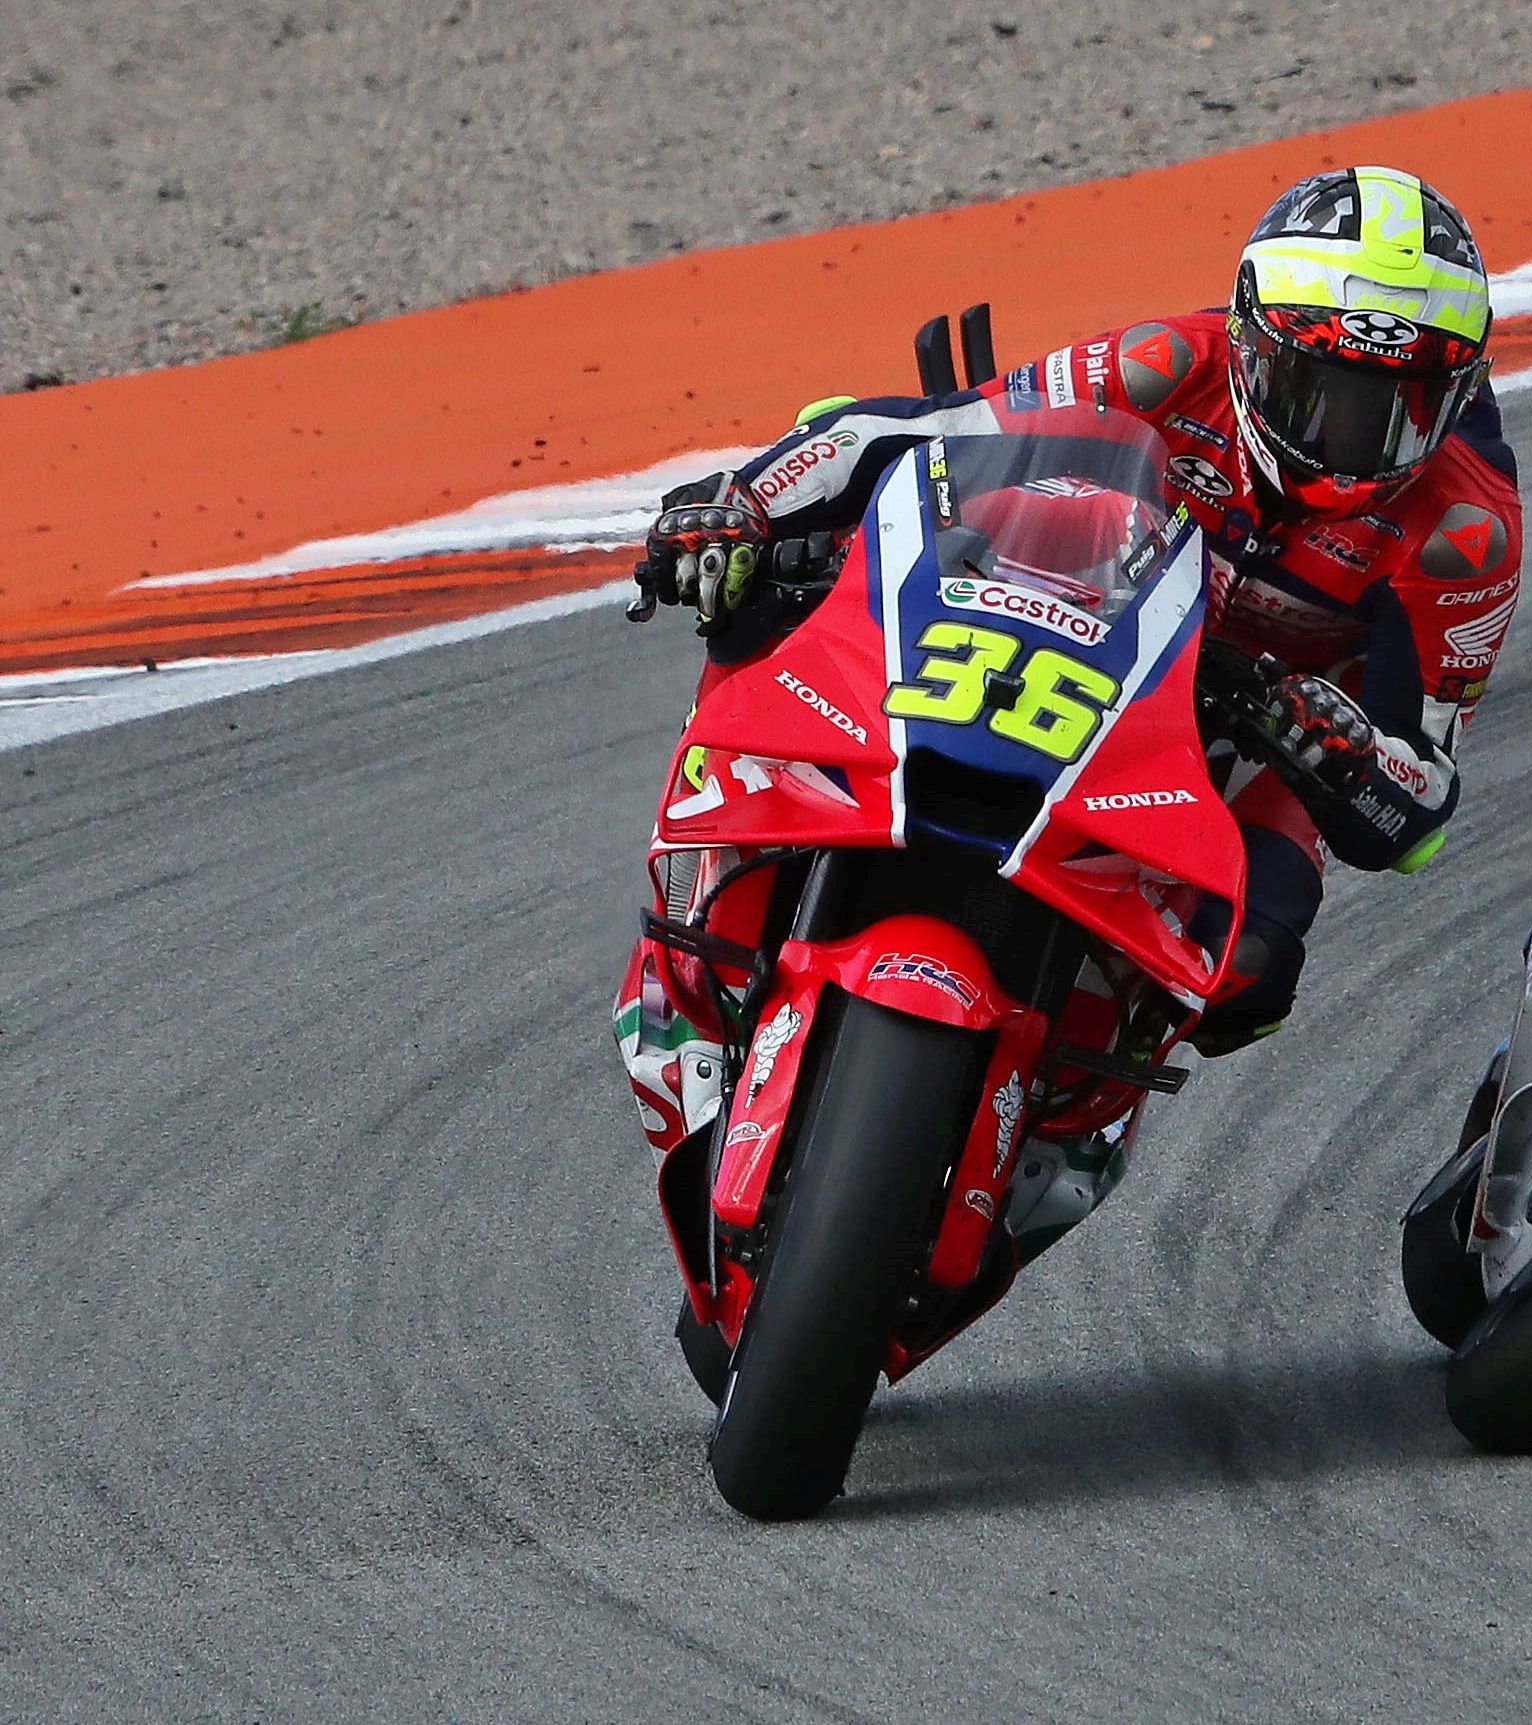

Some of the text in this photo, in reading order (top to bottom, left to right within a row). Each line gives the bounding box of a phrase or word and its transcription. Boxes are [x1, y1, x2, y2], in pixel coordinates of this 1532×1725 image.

[1338, 335, 1413, 361] Kabuto
[753, 442, 837, 508] Castrol
[979, 586, 1101, 643] Castrol
[1440, 650, 1500, 669] HON
[773, 669, 869, 746] HONDA
[884, 621, 1123, 765] 36
[1083, 788, 1199, 812] HONDA
[868, 952, 981, 1008] HRC
